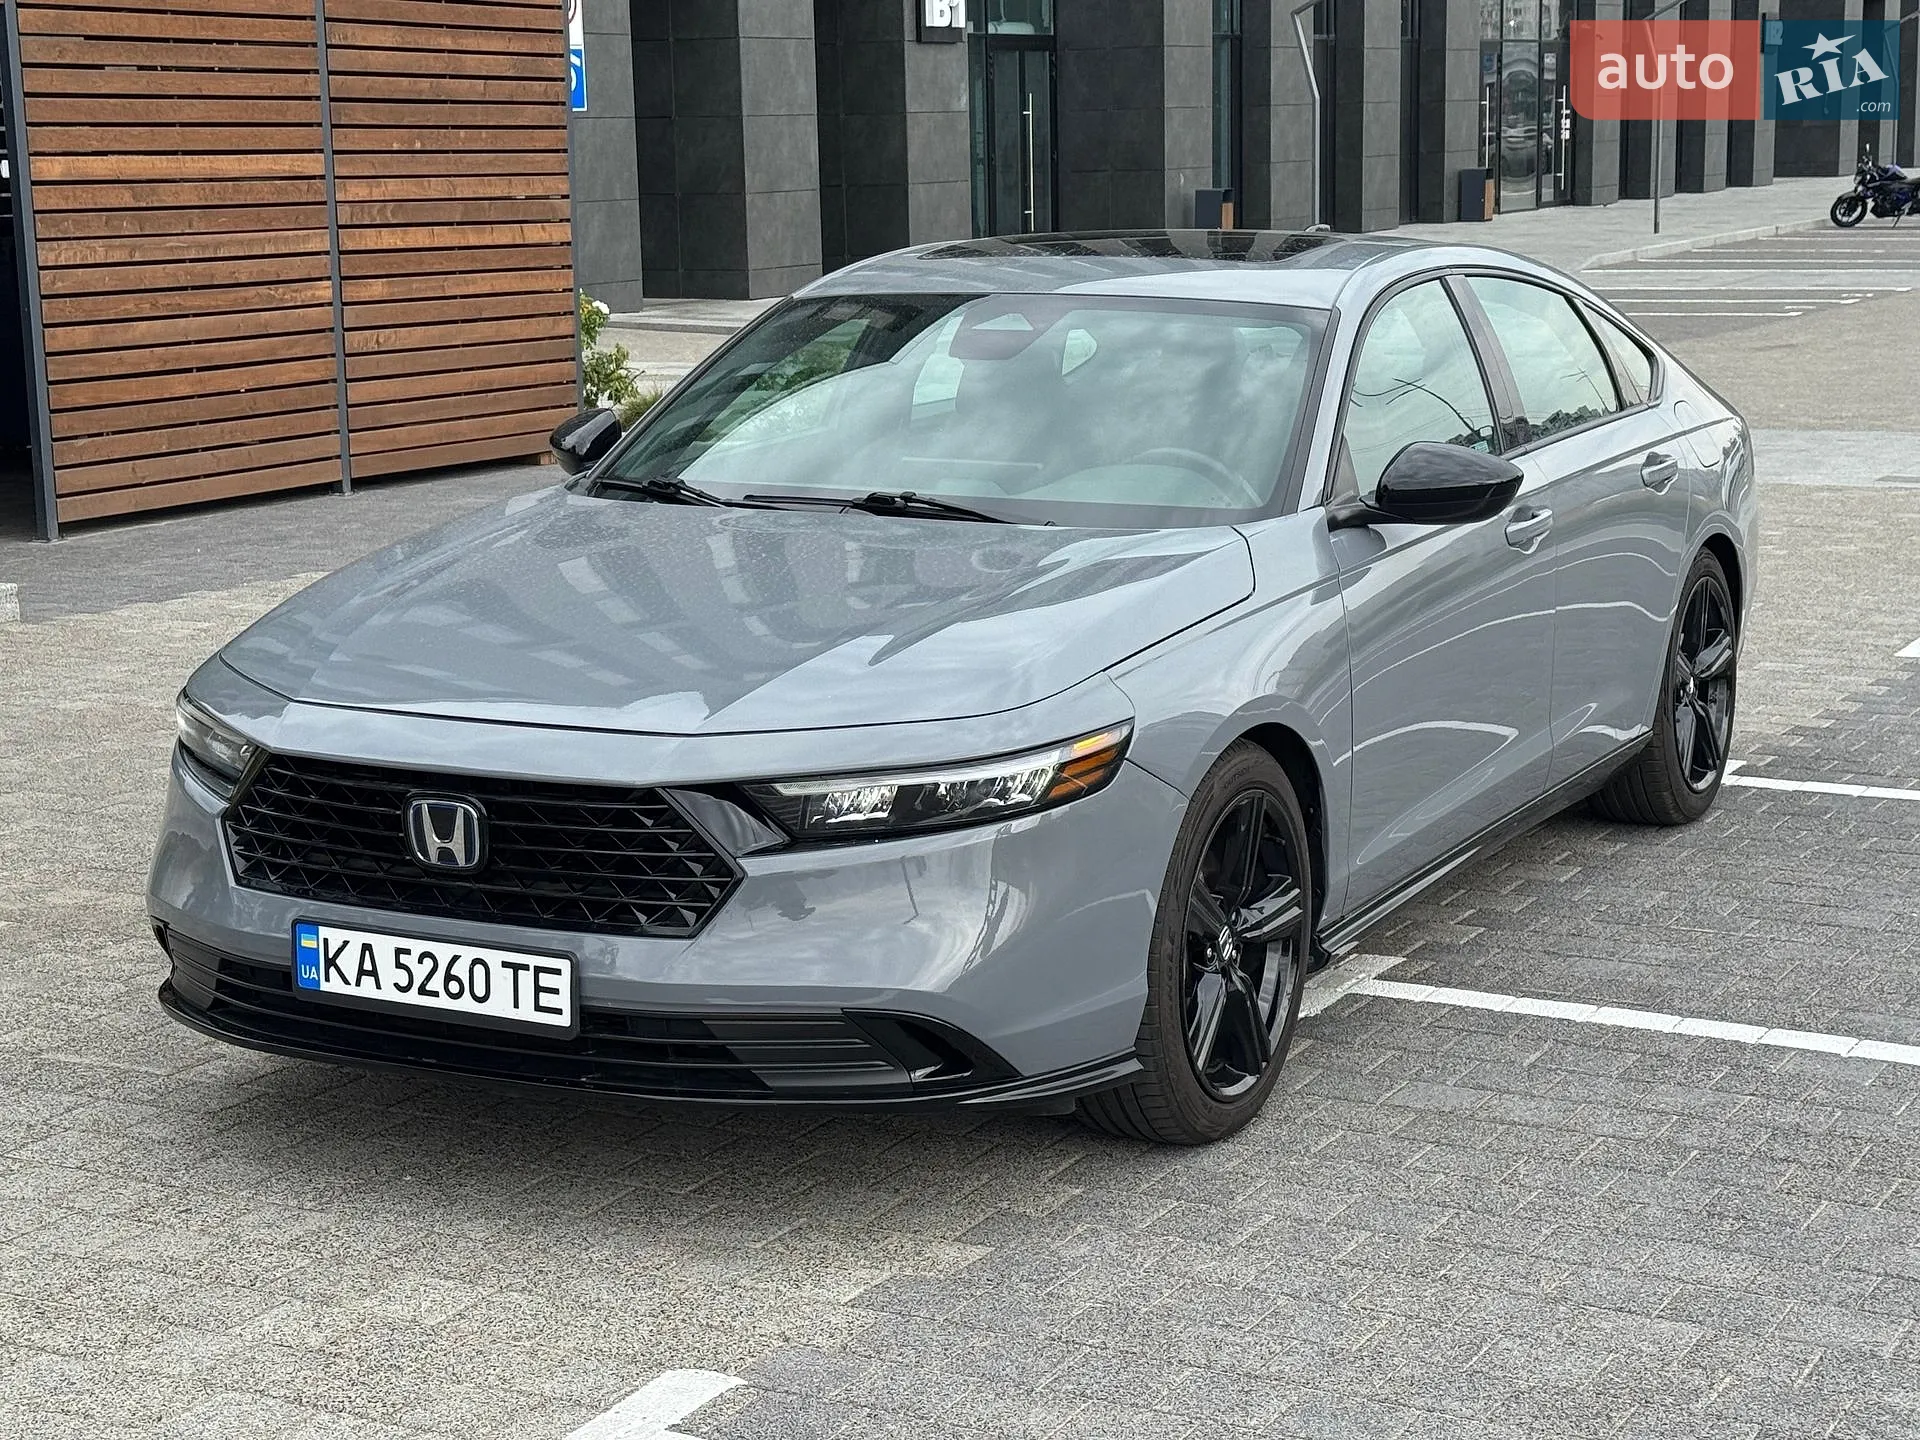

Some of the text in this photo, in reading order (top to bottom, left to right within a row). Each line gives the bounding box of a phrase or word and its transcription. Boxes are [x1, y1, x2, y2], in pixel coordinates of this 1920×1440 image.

[925, 0, 965, 28] B1
[301, 964, 318, 980] UA
[323, 937, 563, 1015] KA 5260 TE
